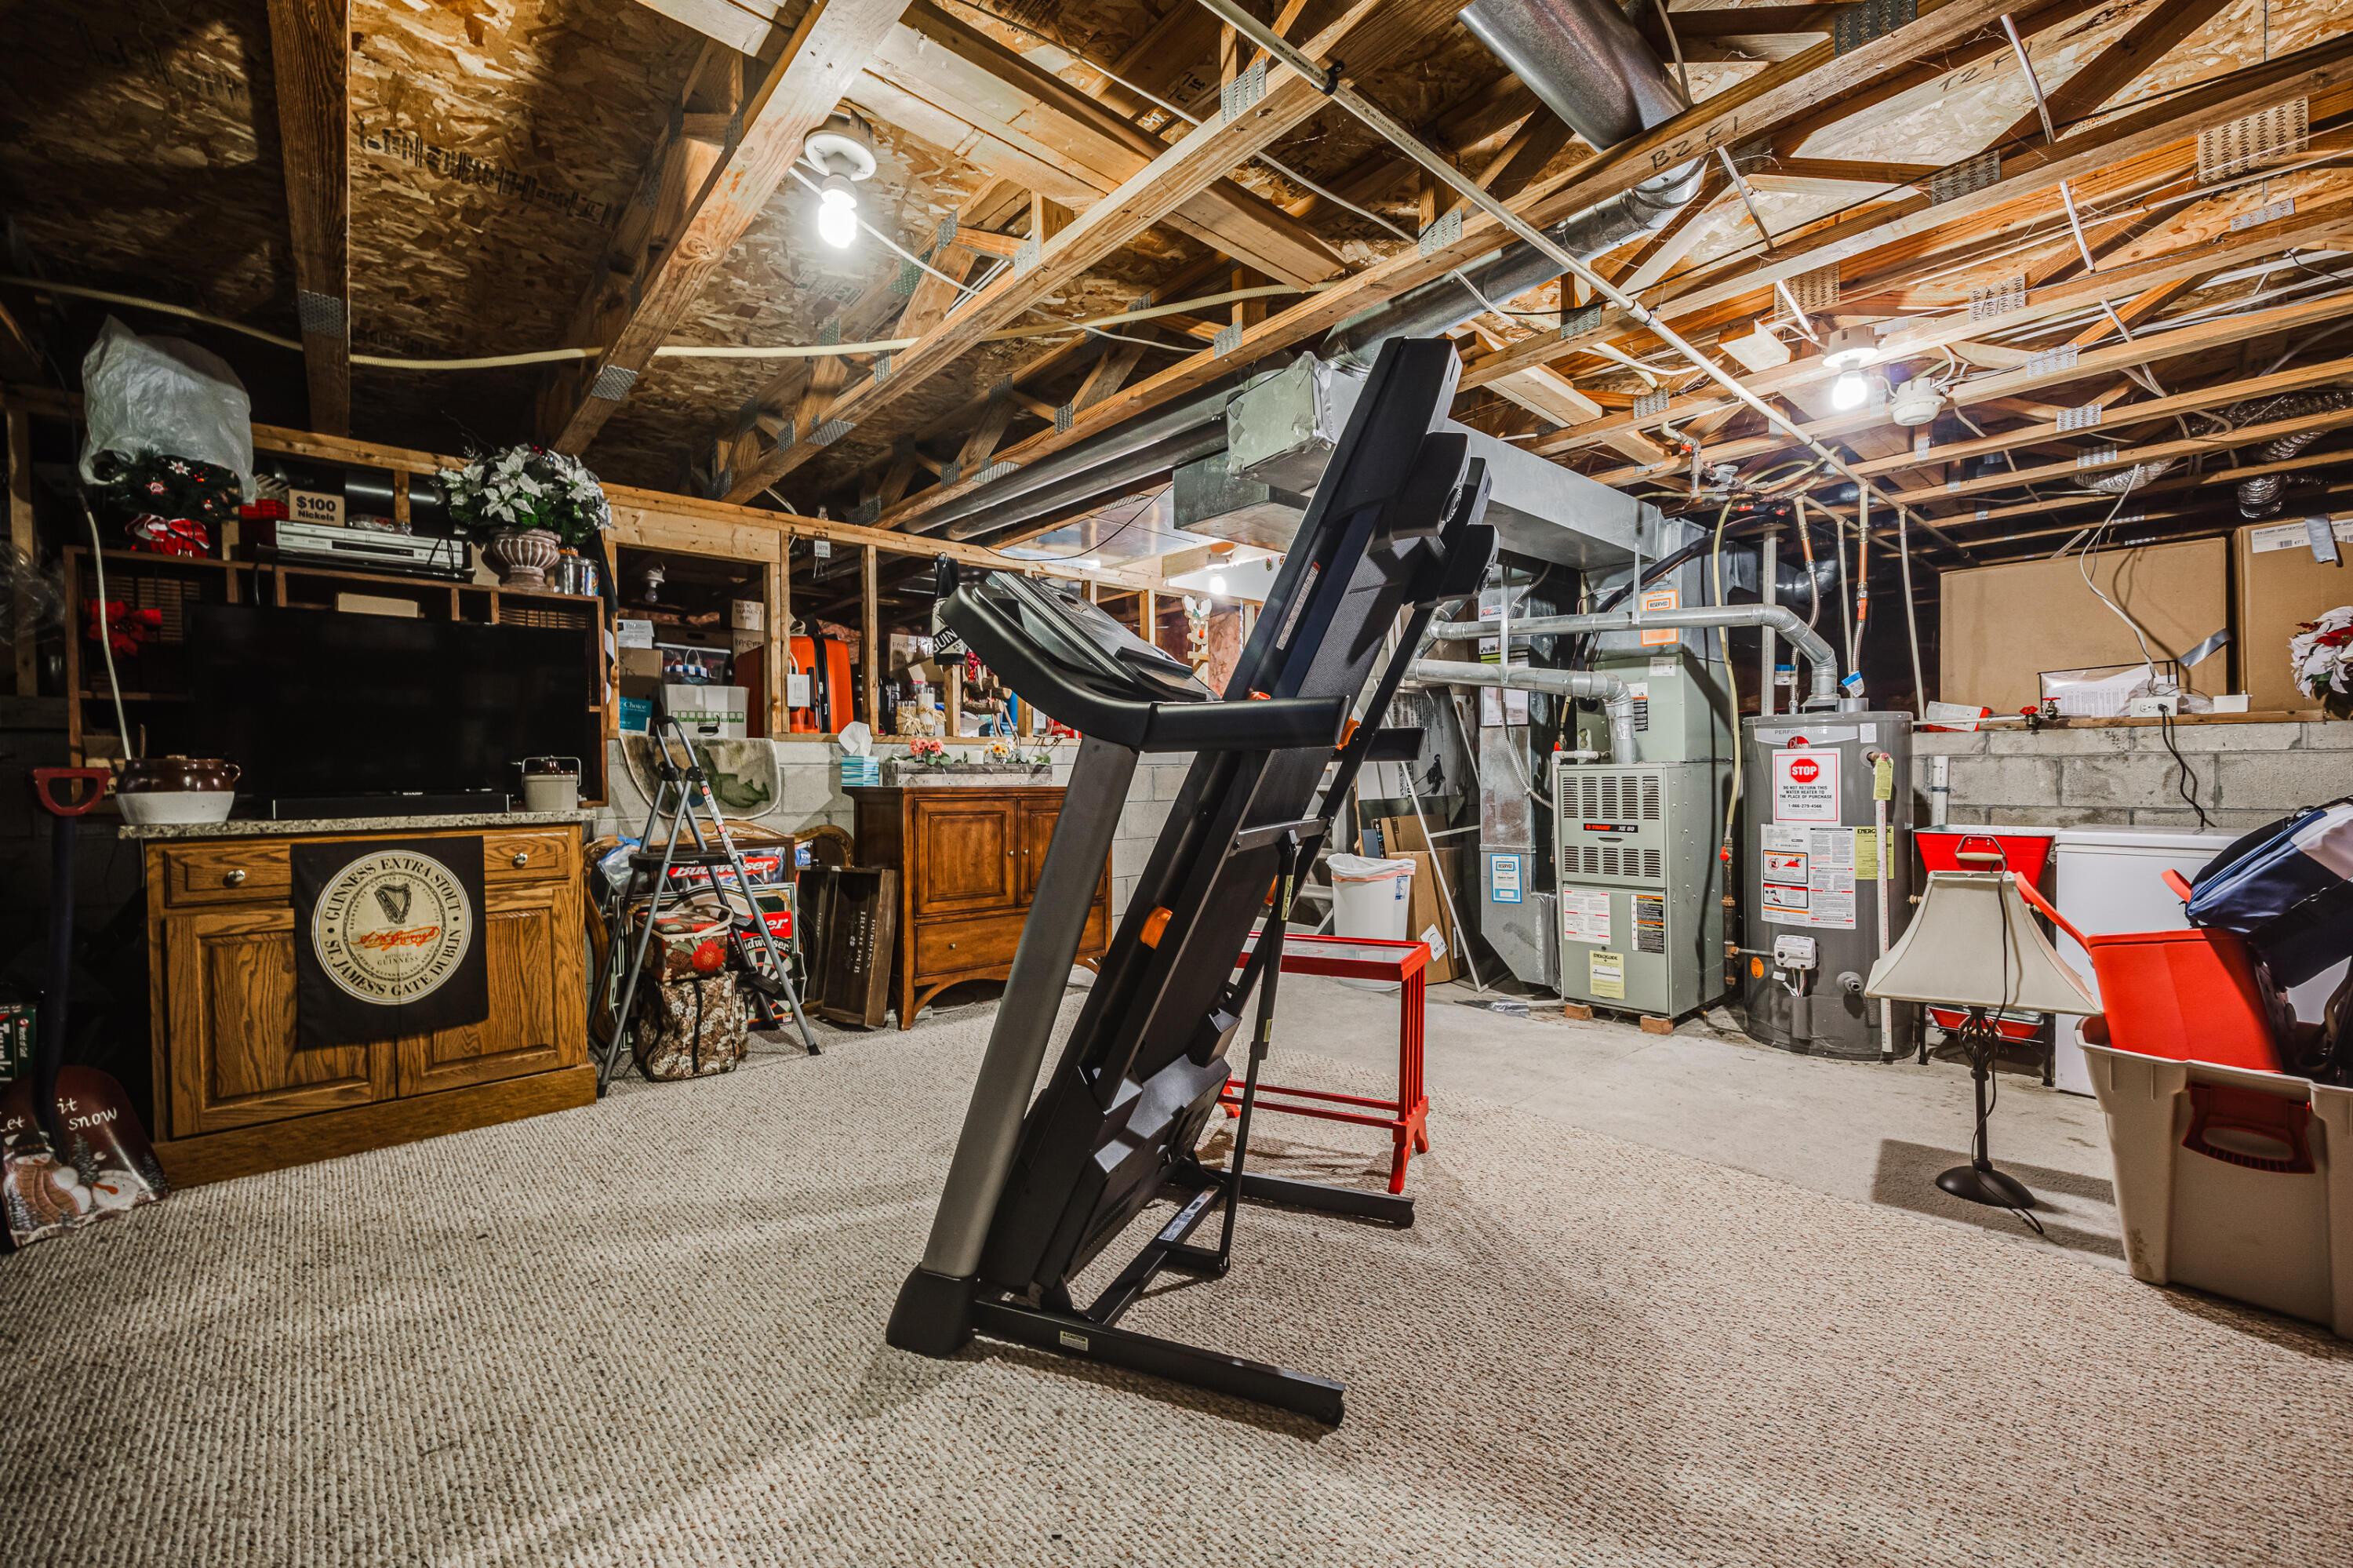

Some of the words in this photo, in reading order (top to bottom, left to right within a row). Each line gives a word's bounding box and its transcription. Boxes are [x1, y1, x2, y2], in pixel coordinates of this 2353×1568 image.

[296, 495, 336, 512] $100
[297, 510, 336, 522] Nickels
[933, 628, 958, 653] GUIN
[1791, 766, 1817, 776] STOP
[673, 860, 774, 878] Budweser
[325, 863, 376, 921] GUINNESS
[380, 857, 431, 878] EXTRA
[431, 873, 462, 913] STOUT
[858, 911, 867, 946] IRISH
[325, 940, 343, 960] ST.
[376, 956, 419, 966] GUINNESS
[430, 929, 463, 977] DUBLIN
[853, 949, 862, 973] PUB
[333, 959, 387, 995] JAMES'S
[391, 974, 433, 996] GATE
[57, 1097, 78, 1115] it
[68, 1107, 118, 1131] snow
